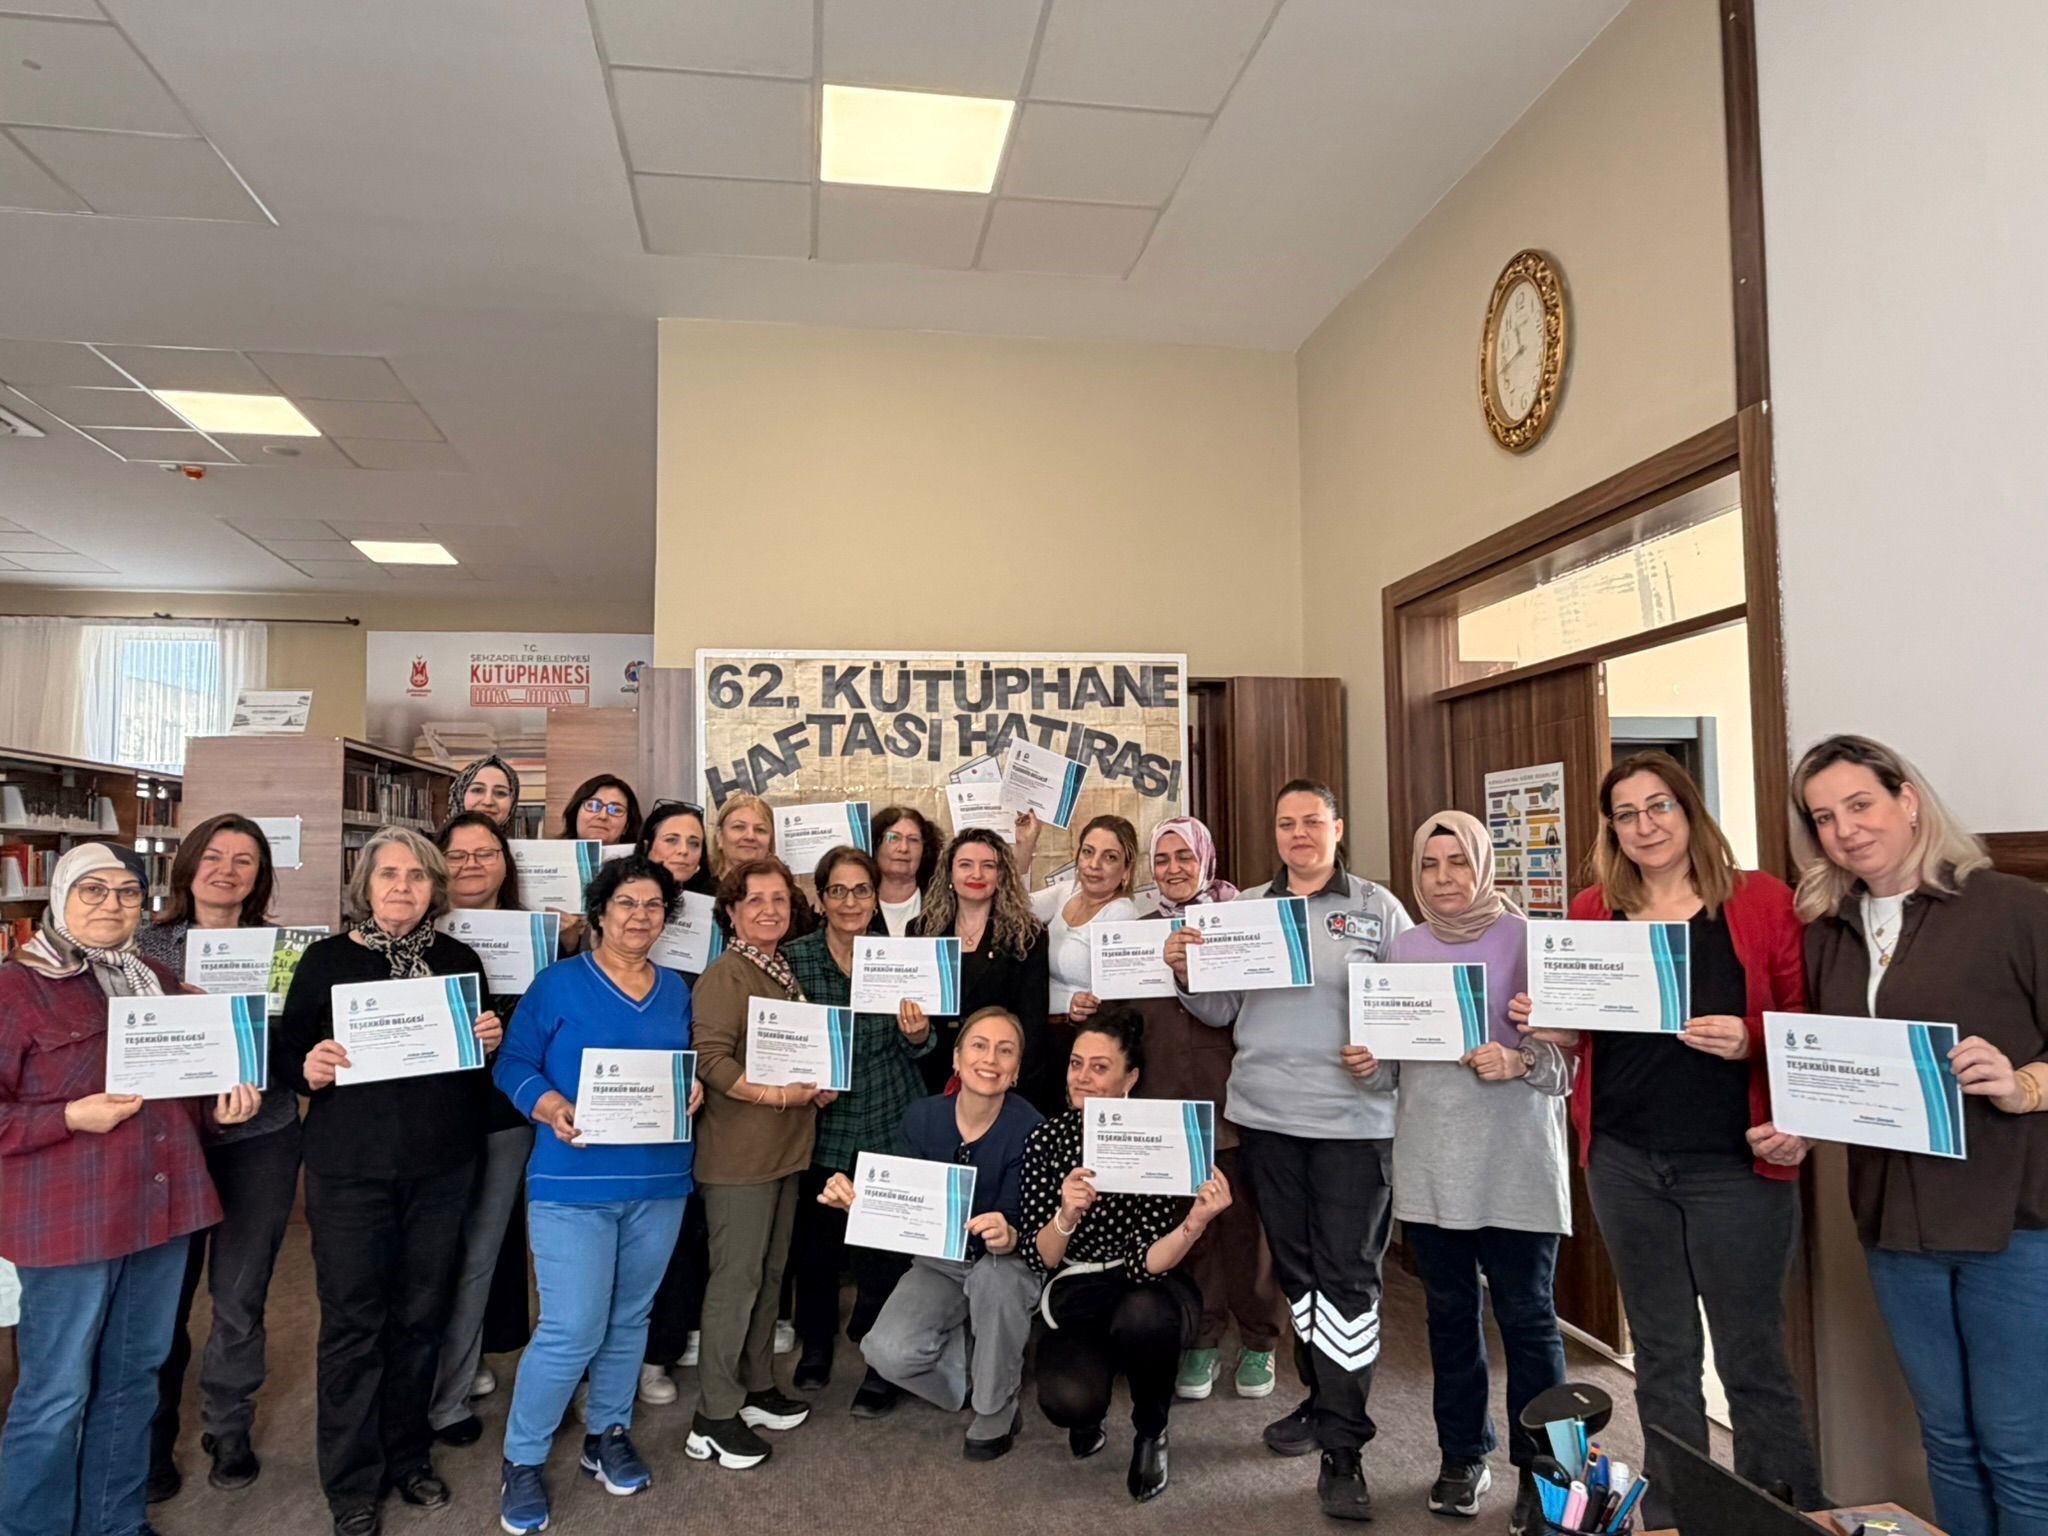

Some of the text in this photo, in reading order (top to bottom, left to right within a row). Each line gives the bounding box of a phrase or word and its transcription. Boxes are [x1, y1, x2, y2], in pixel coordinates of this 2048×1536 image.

[470, 664, 590, 684] KÜTÜPHANESİ
[707, 661, 1179, 713] 62. KÜTÜPHANE
[704, 712, 1182, 811] HAFTASI HATIRASI
[1786, 1059, 1881, 1078] TEŞEKKÜR BELGESİ
